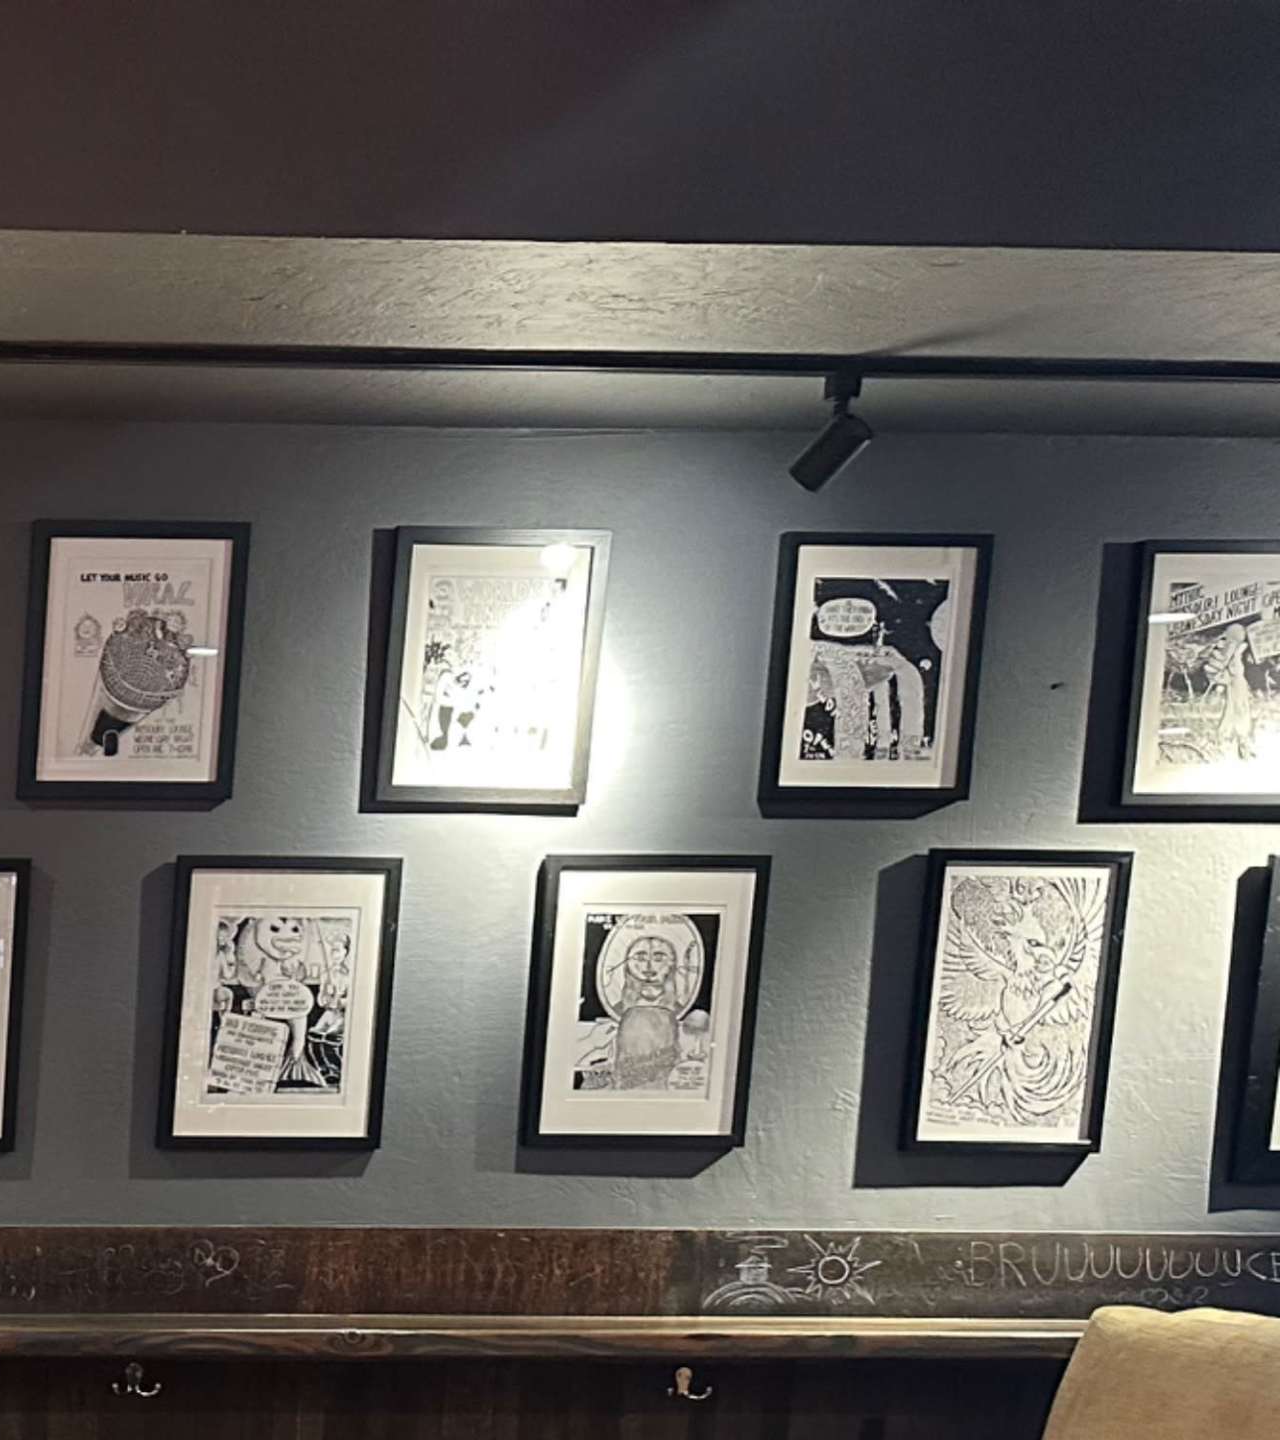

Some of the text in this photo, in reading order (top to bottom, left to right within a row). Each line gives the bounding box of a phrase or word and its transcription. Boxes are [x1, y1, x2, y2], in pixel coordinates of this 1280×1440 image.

[81, 573, 97, 582] LET
[100, 573, 121, 582] YOUR
[125, 573, 151, 582] MUSIC
